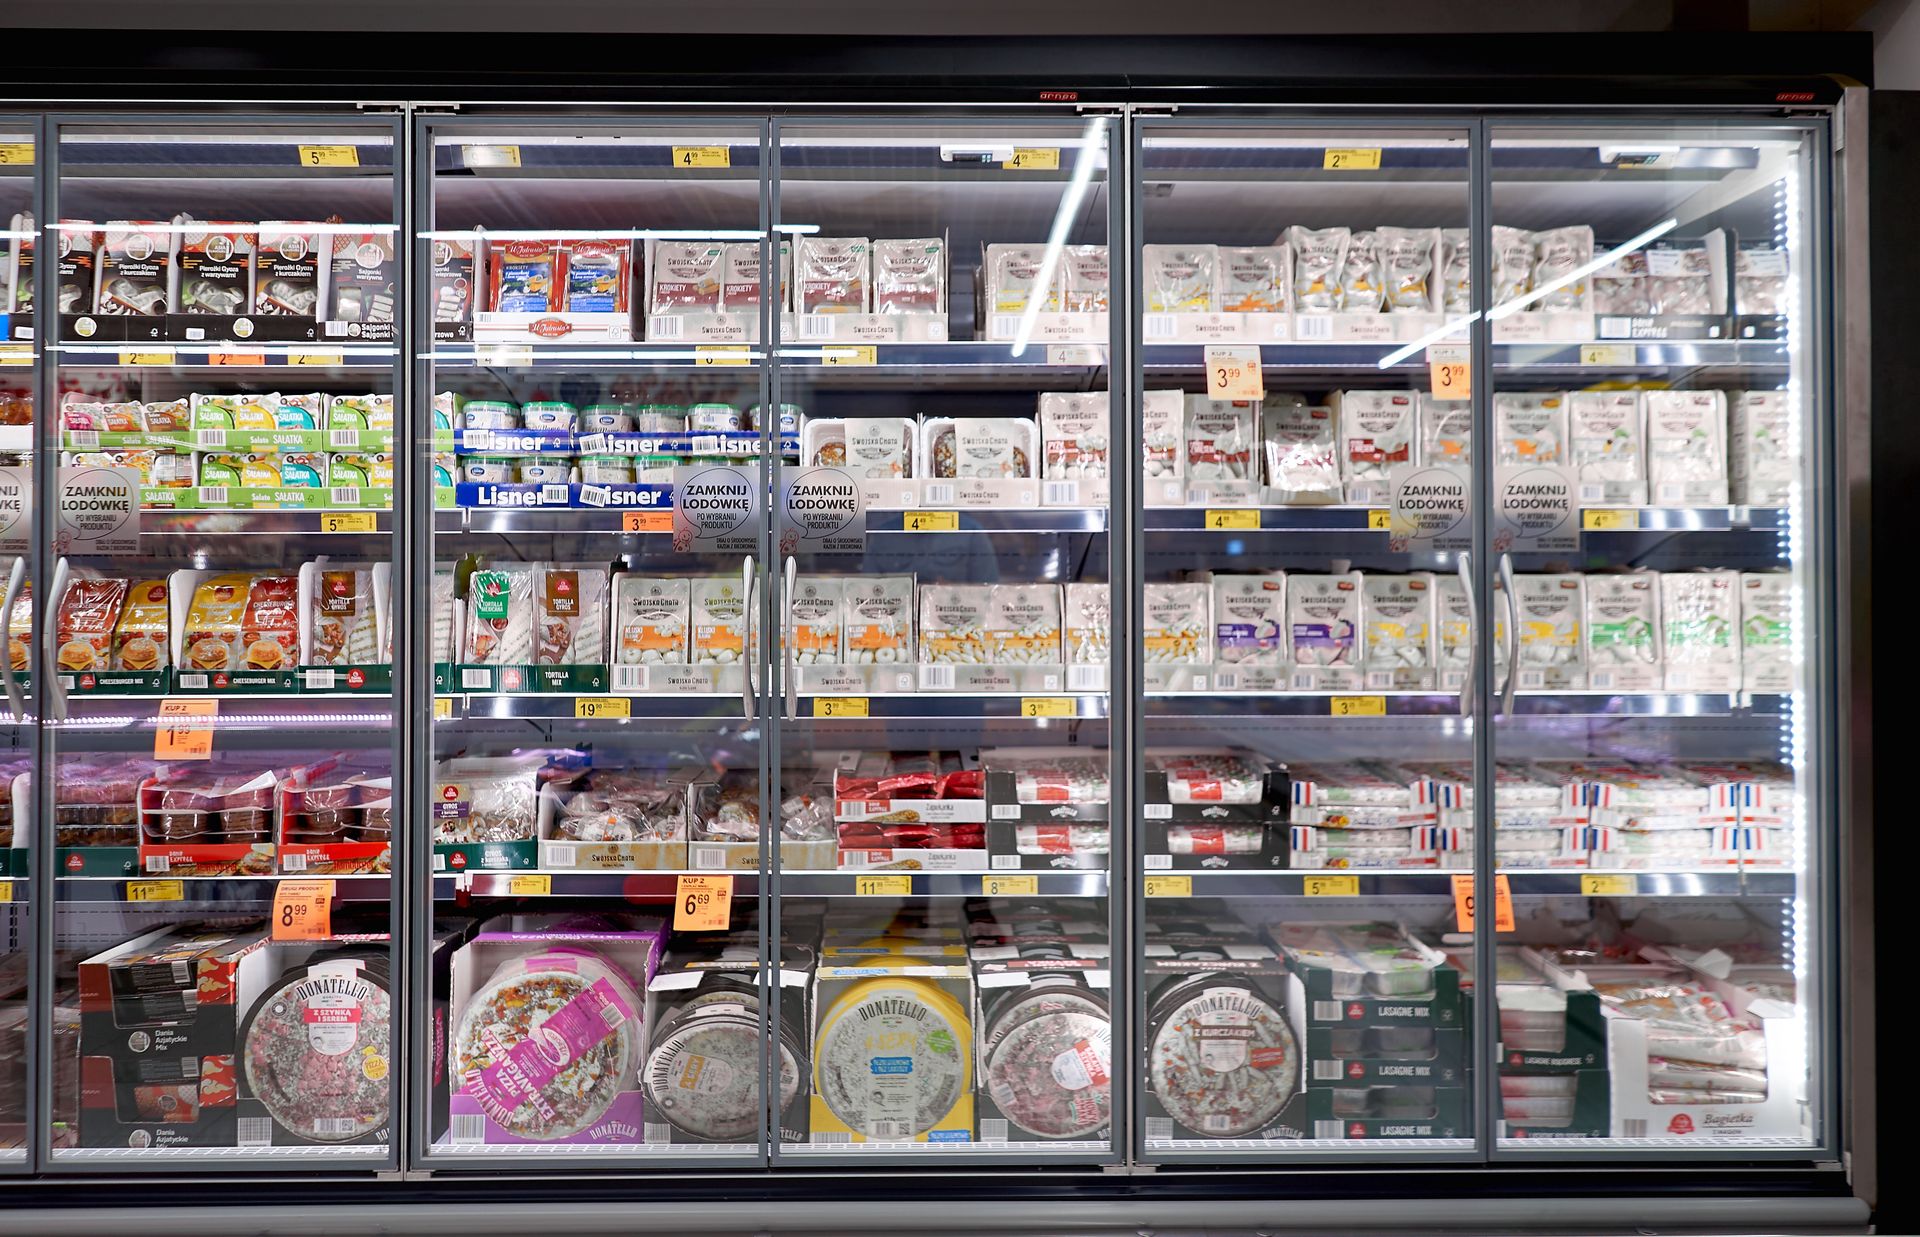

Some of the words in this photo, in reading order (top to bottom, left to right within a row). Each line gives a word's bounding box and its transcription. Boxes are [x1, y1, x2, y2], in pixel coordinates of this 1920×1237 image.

[488, 431, 546, 450] isner
[606, 434, 664, 453] isner
[66, 486, 127, 497] ZAMKNIJ
[606, 485, 662, 505] isner
[686, 485, 747, 496] ZAMKNIJ
[793, 485, 853, 496] ZAMKNIJ
[1403, 486, 1462, 496] ZAMKNIJ
[1507, 485, 1567, 495] ZAMKNIJ
[62, 497, 129, 513] LODÓWKĘ
[682, 496, 749, 512] LODÓWKĘ
[788, 496, 855, 512] LODÓWKĘ
[1399, 496, 1464, 513] LODÓWKĘ
[1503, 496, 1568, 512] LODÓWKĘ
[696, 513, 705, 521] PO
[705, 513, 737, 521] WYBRANIU
[701, 521, 733, 529] PRODUKTU
[802, 513, 811, 521] PO
[812, 513, 843, 521] WYBRANIU
[807, 521, 839, 529] PRODUKTU
[134, 677, 144, 685] MIX
[232, 677, 266, 685] CHEESEBURGER
[267, 677, 276, 685] MIX
[295, 978, 369, 1001] DONATELLO
[858, 999, 928, 1023] DONATELLO
[1192, 996, 1262, 1019] DONATELLO
[1201, 1028, 1257, 1037] KURCZAKIEM
[652, 1039, 685, 1092] DONATELLO
[494, 1069, 521, 1098] PIZZA
[1703, 1112, 1754, 1125] Bagietka
[589, 1122, 638, 1140] DONATELLO
